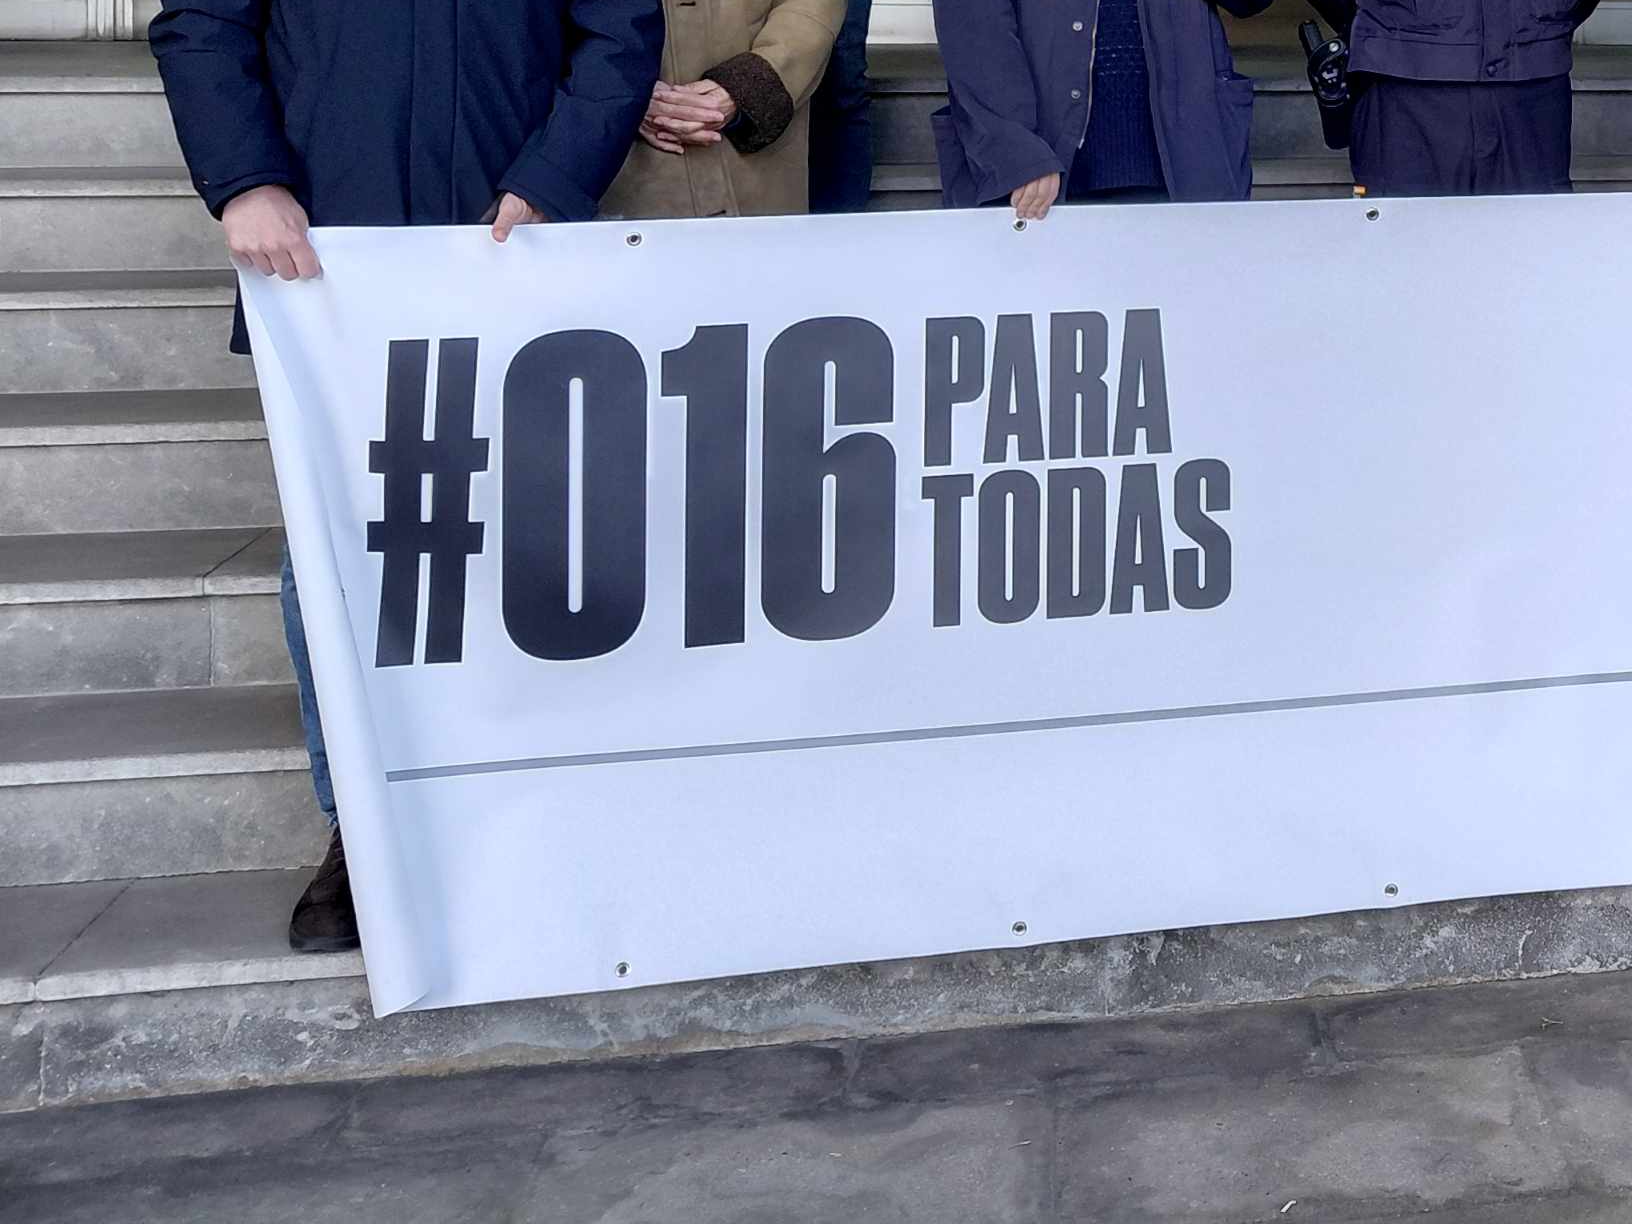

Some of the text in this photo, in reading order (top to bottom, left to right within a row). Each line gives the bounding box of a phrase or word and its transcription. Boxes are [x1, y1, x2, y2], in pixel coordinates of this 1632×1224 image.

[923, 308, 1173, 467] PARA
[366, 316, 896, 669] #016
[921, 458, 1232, 628] TODAS
